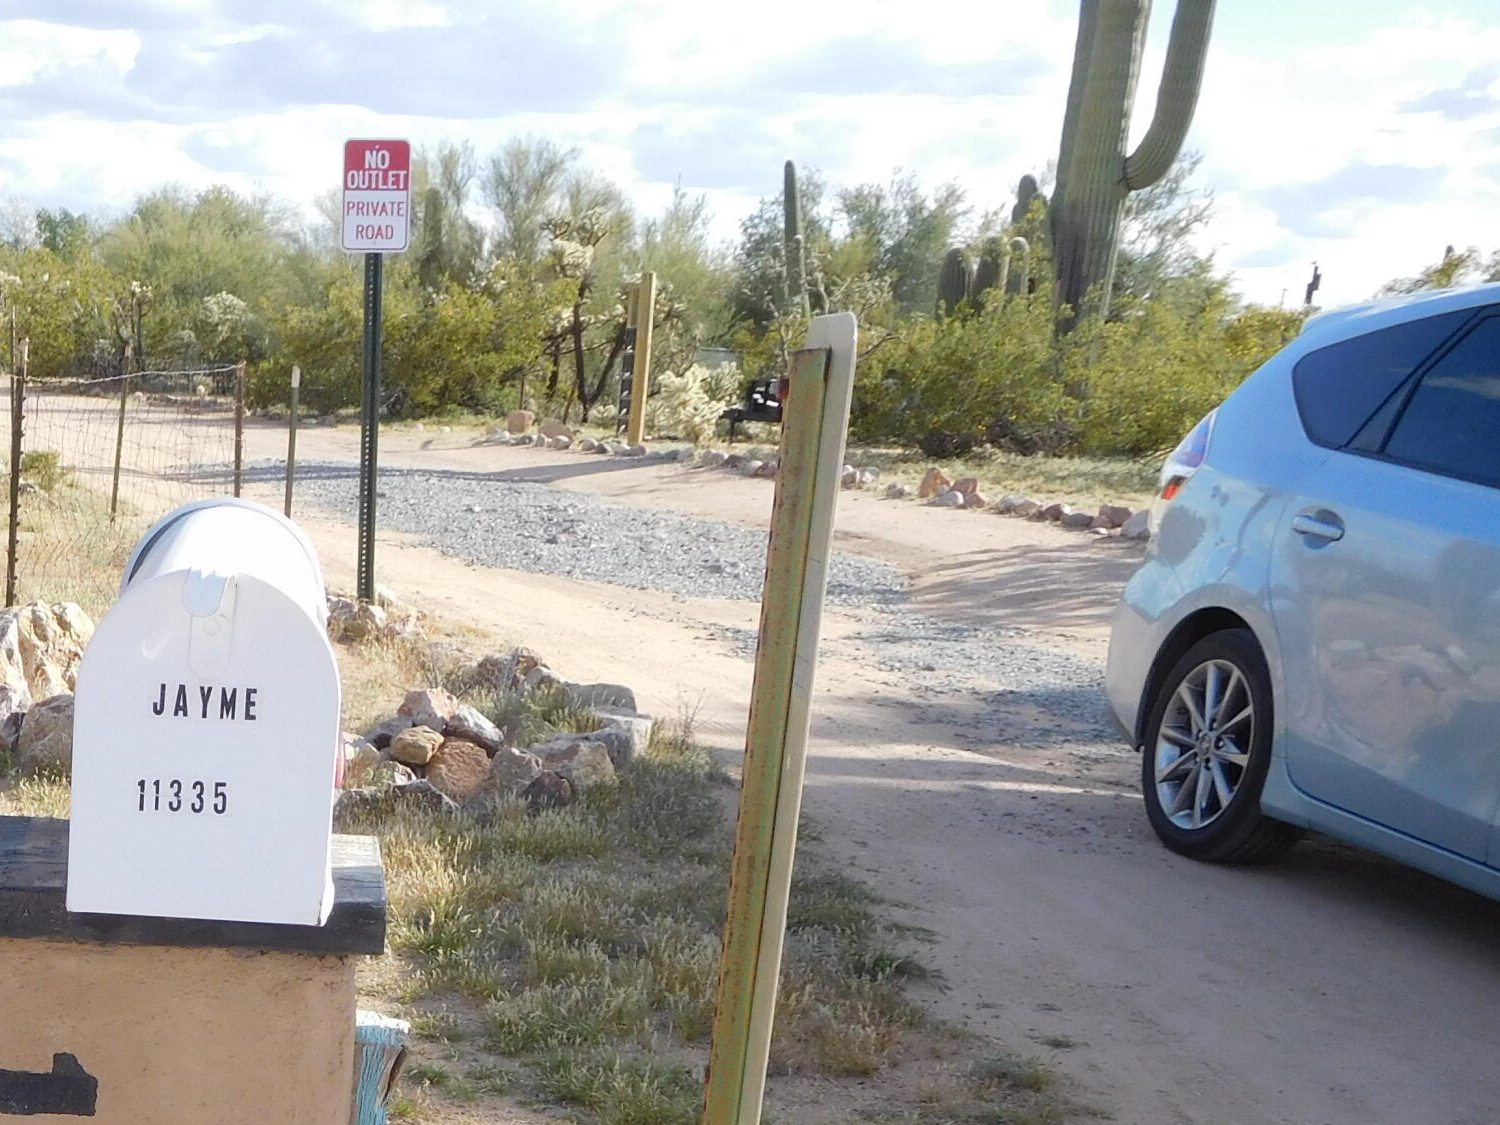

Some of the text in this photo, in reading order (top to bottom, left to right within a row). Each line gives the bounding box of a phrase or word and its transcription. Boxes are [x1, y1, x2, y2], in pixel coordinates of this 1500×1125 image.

[365, 150, 390, 169] NO
[347, 170, 407, 189] OUTLET
[347, 201, 405, 217] PRIVATE
[356, 225, 393, 240] ROAD
[153, 683, 257, 720] JAYME
[138, 779, 227, 814] 11335
